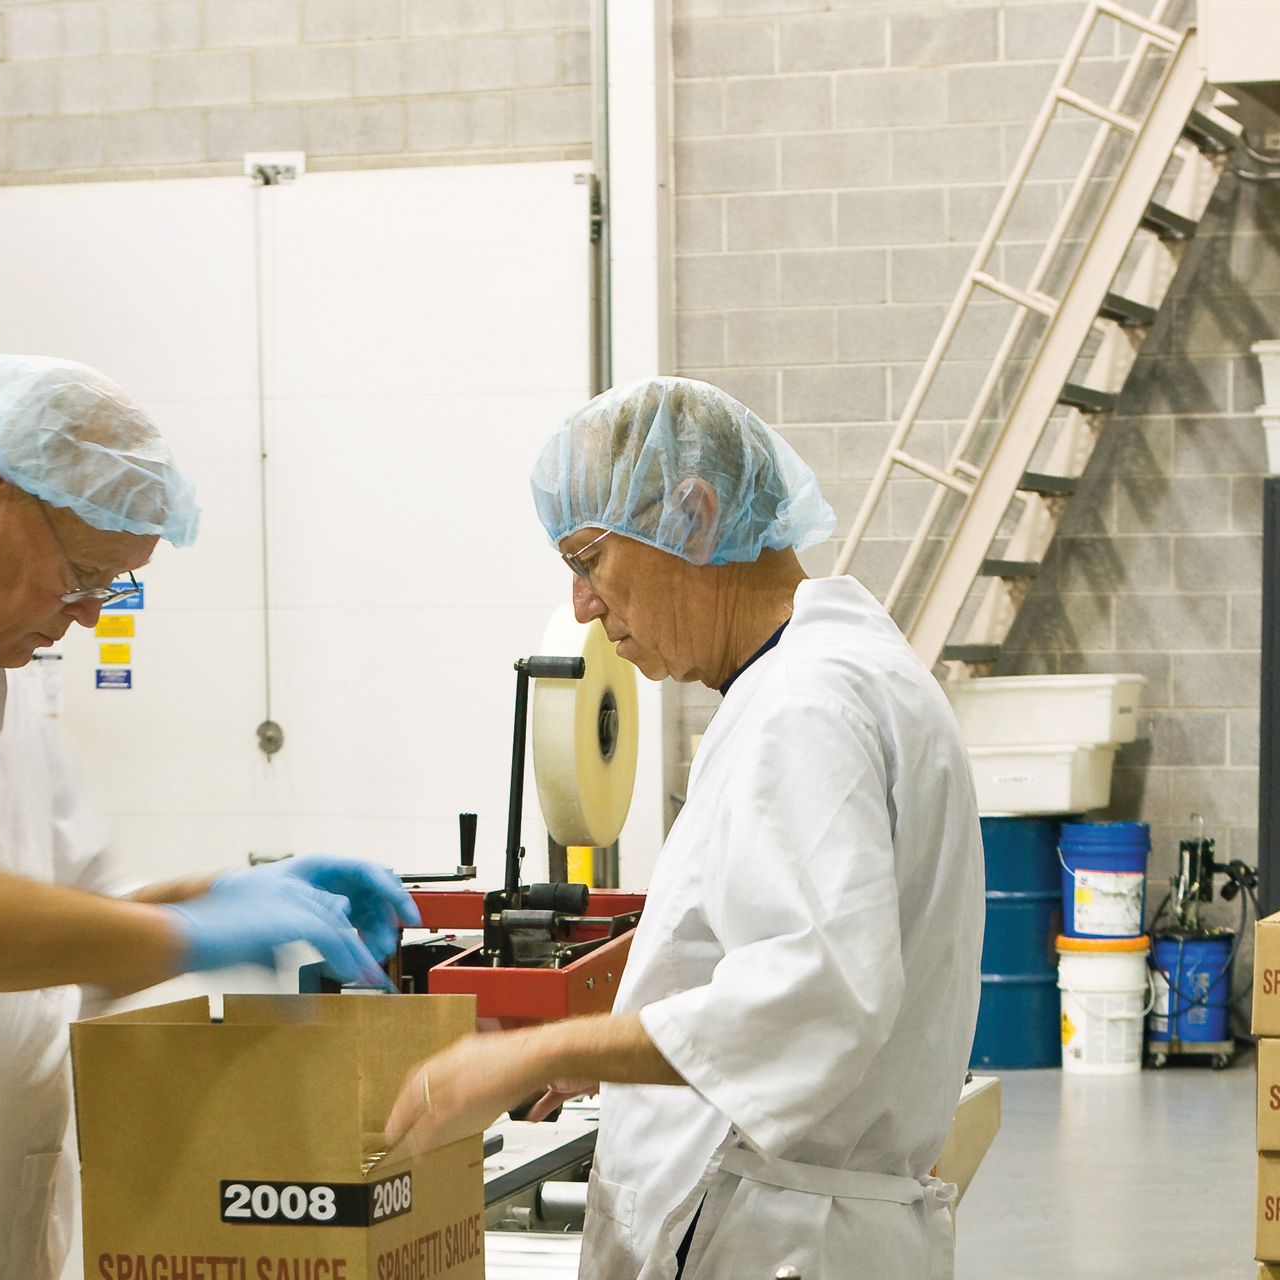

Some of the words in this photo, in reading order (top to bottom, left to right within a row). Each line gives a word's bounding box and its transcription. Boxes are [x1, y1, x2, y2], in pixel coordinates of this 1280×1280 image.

[224, 1184, 337, 1221] 2008
[373, 1175, 412, 1219] 2008
[445, 1213, 481, 1271] SAUCE
